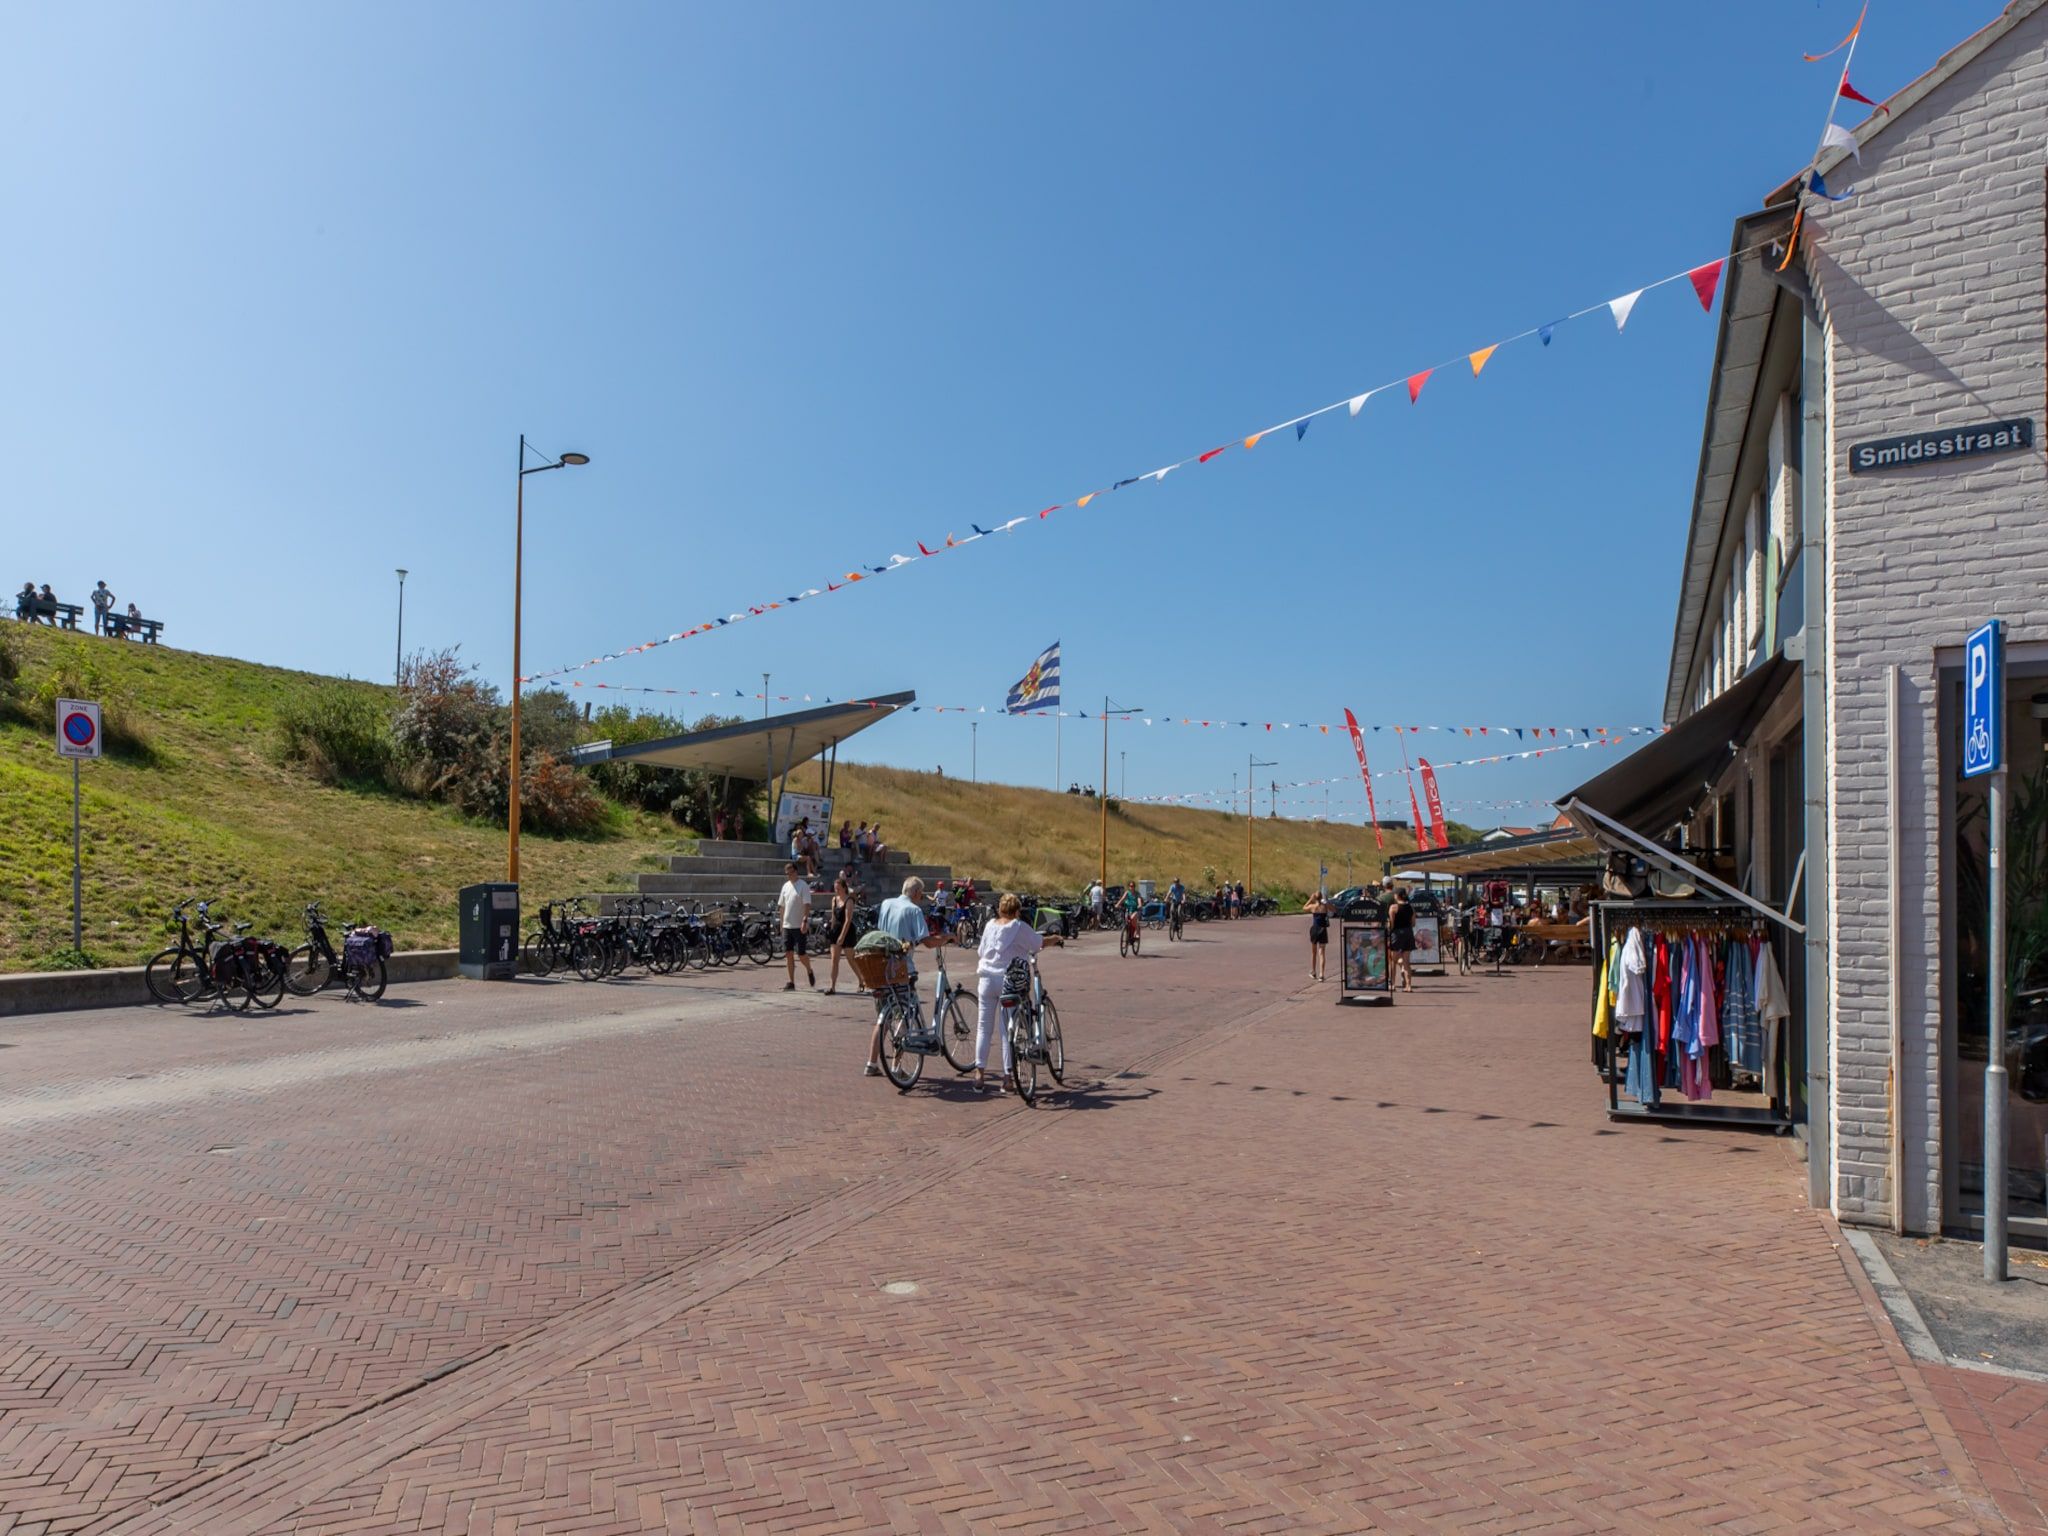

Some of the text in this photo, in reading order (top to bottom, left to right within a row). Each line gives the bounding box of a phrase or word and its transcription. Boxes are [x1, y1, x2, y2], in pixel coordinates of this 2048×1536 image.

[1859, 425, 2022, 467] Smidsstraat
[1971, 643, 1987, 716] P
[70, 704, 88, 712] ZONE
